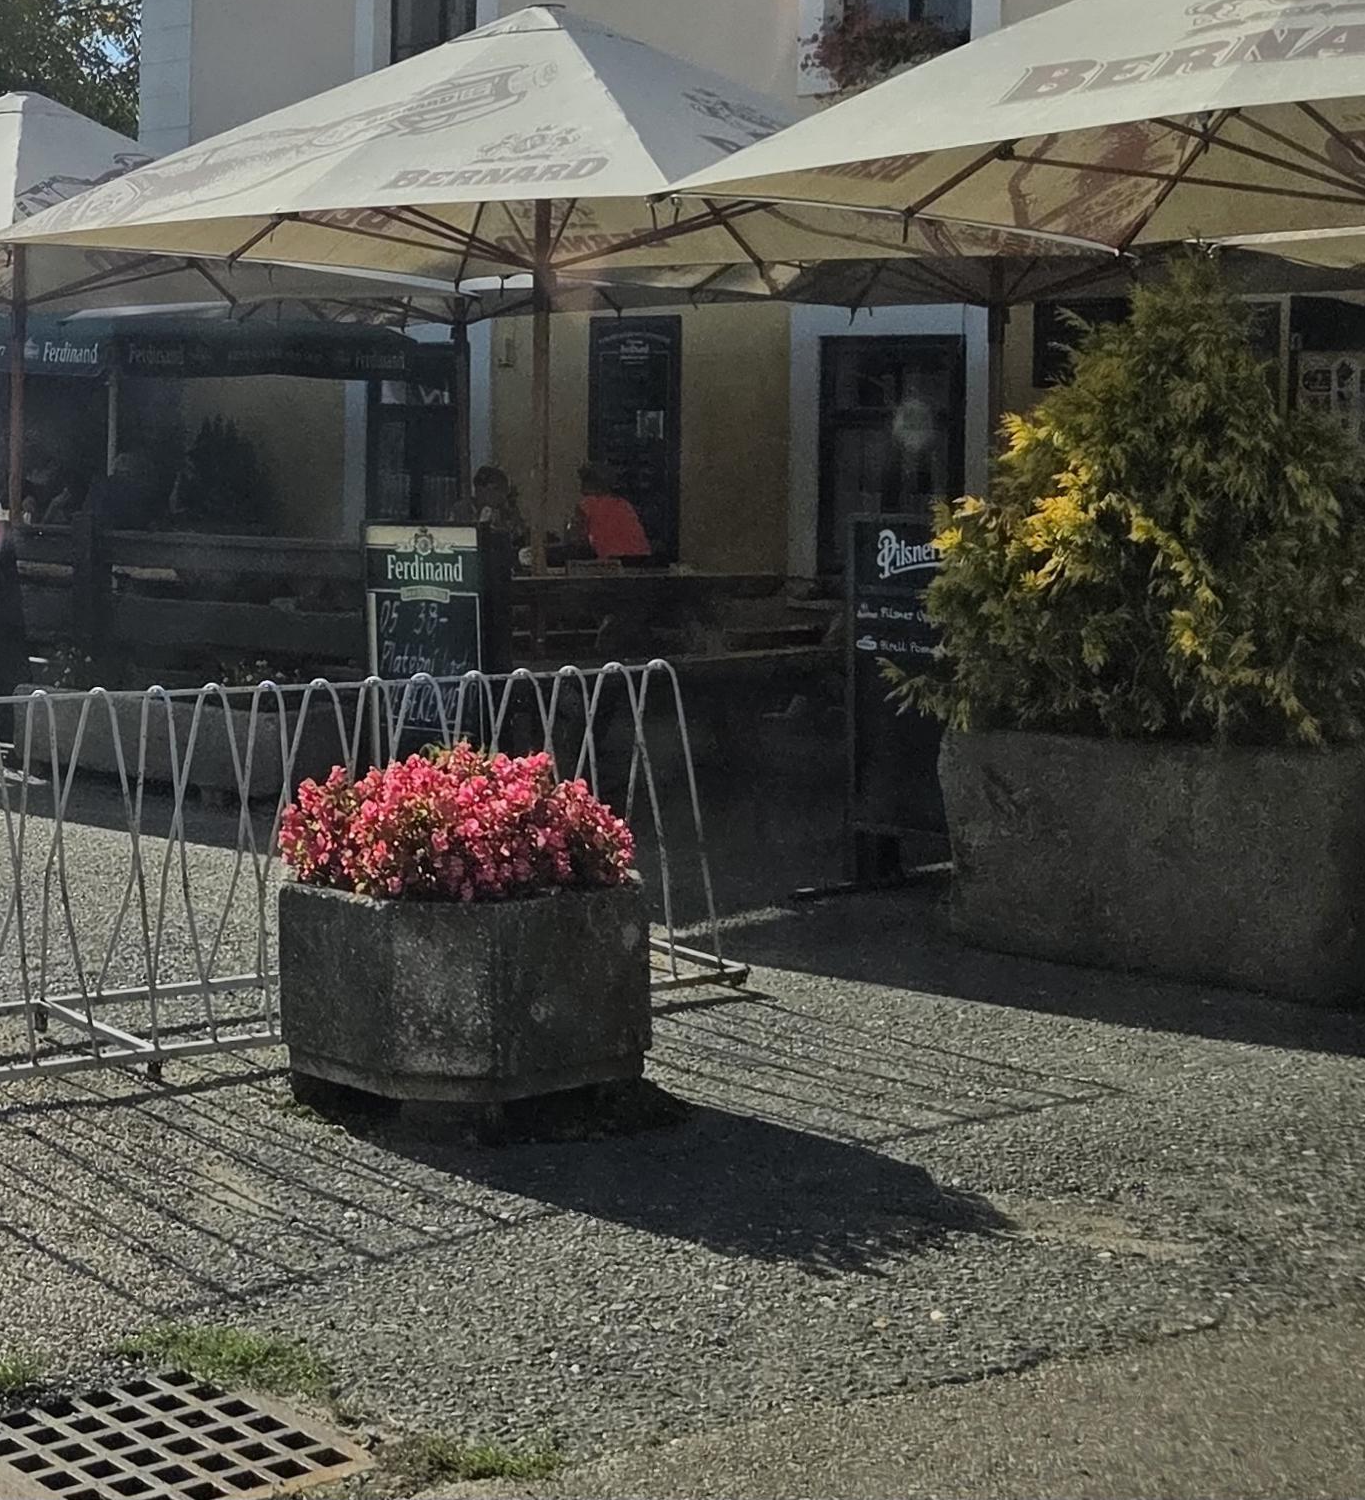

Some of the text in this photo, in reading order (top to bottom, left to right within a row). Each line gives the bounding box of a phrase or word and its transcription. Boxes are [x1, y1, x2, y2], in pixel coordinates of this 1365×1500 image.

[381, 156, 608, 190] BERNARD
[42, 342, 98, 364] Ferdinand
[386, 553, 463, 582] Ferdinand
[876, 529, 937, 580] Pilsner
